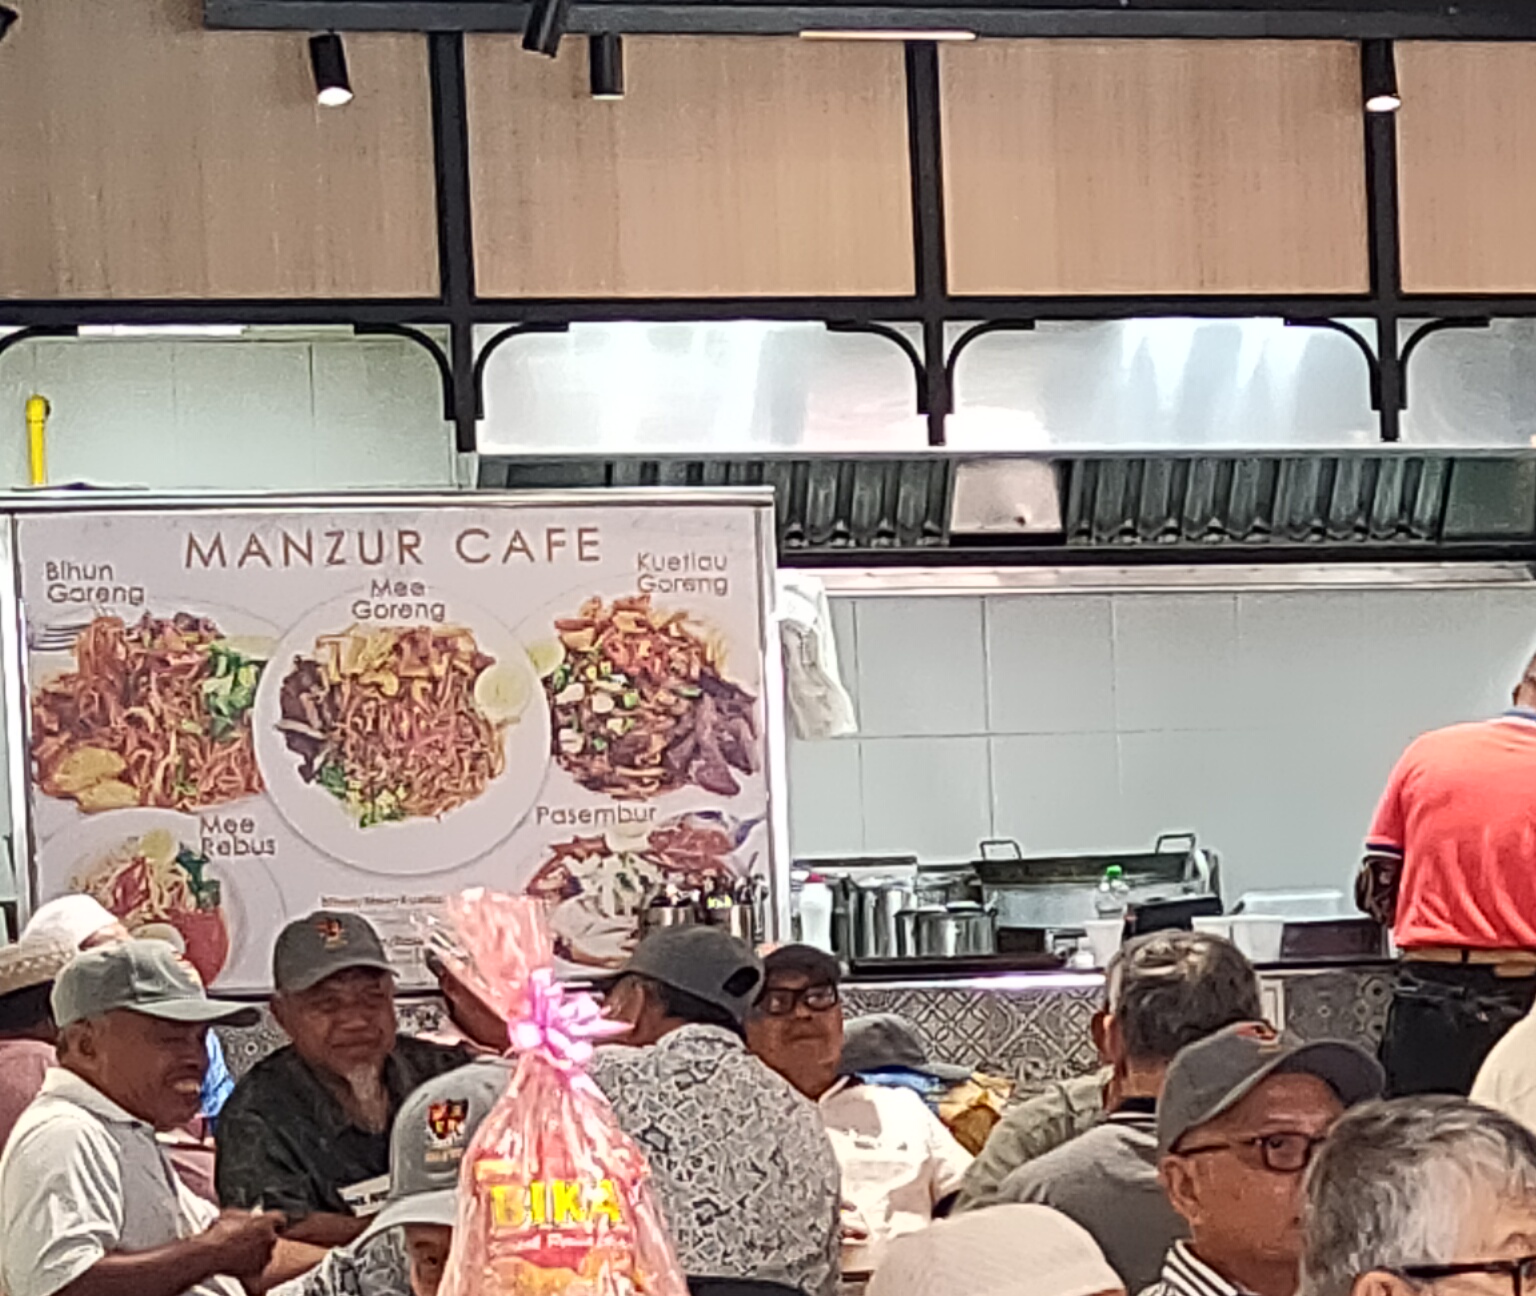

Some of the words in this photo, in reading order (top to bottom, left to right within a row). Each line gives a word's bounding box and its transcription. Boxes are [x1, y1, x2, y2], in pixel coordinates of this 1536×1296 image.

[185, 530, 423, 568] MANZUR
[456, 527, 600, 564] CAFE
[46, 560, 113, 581] Bihun
[47, 583, 144, 605] Goreng
[371, 579, 425, 597] Mee
[637, 574, 728, 596] Goreng
[352, 600, 445, 622] Goreng
[200, 815, 255, 834] Mee
[536, 804, 656, 826] Pasembur
[201, 835, 275, 856] Rebus
[491, 1178, 621, 1226] BIKA
